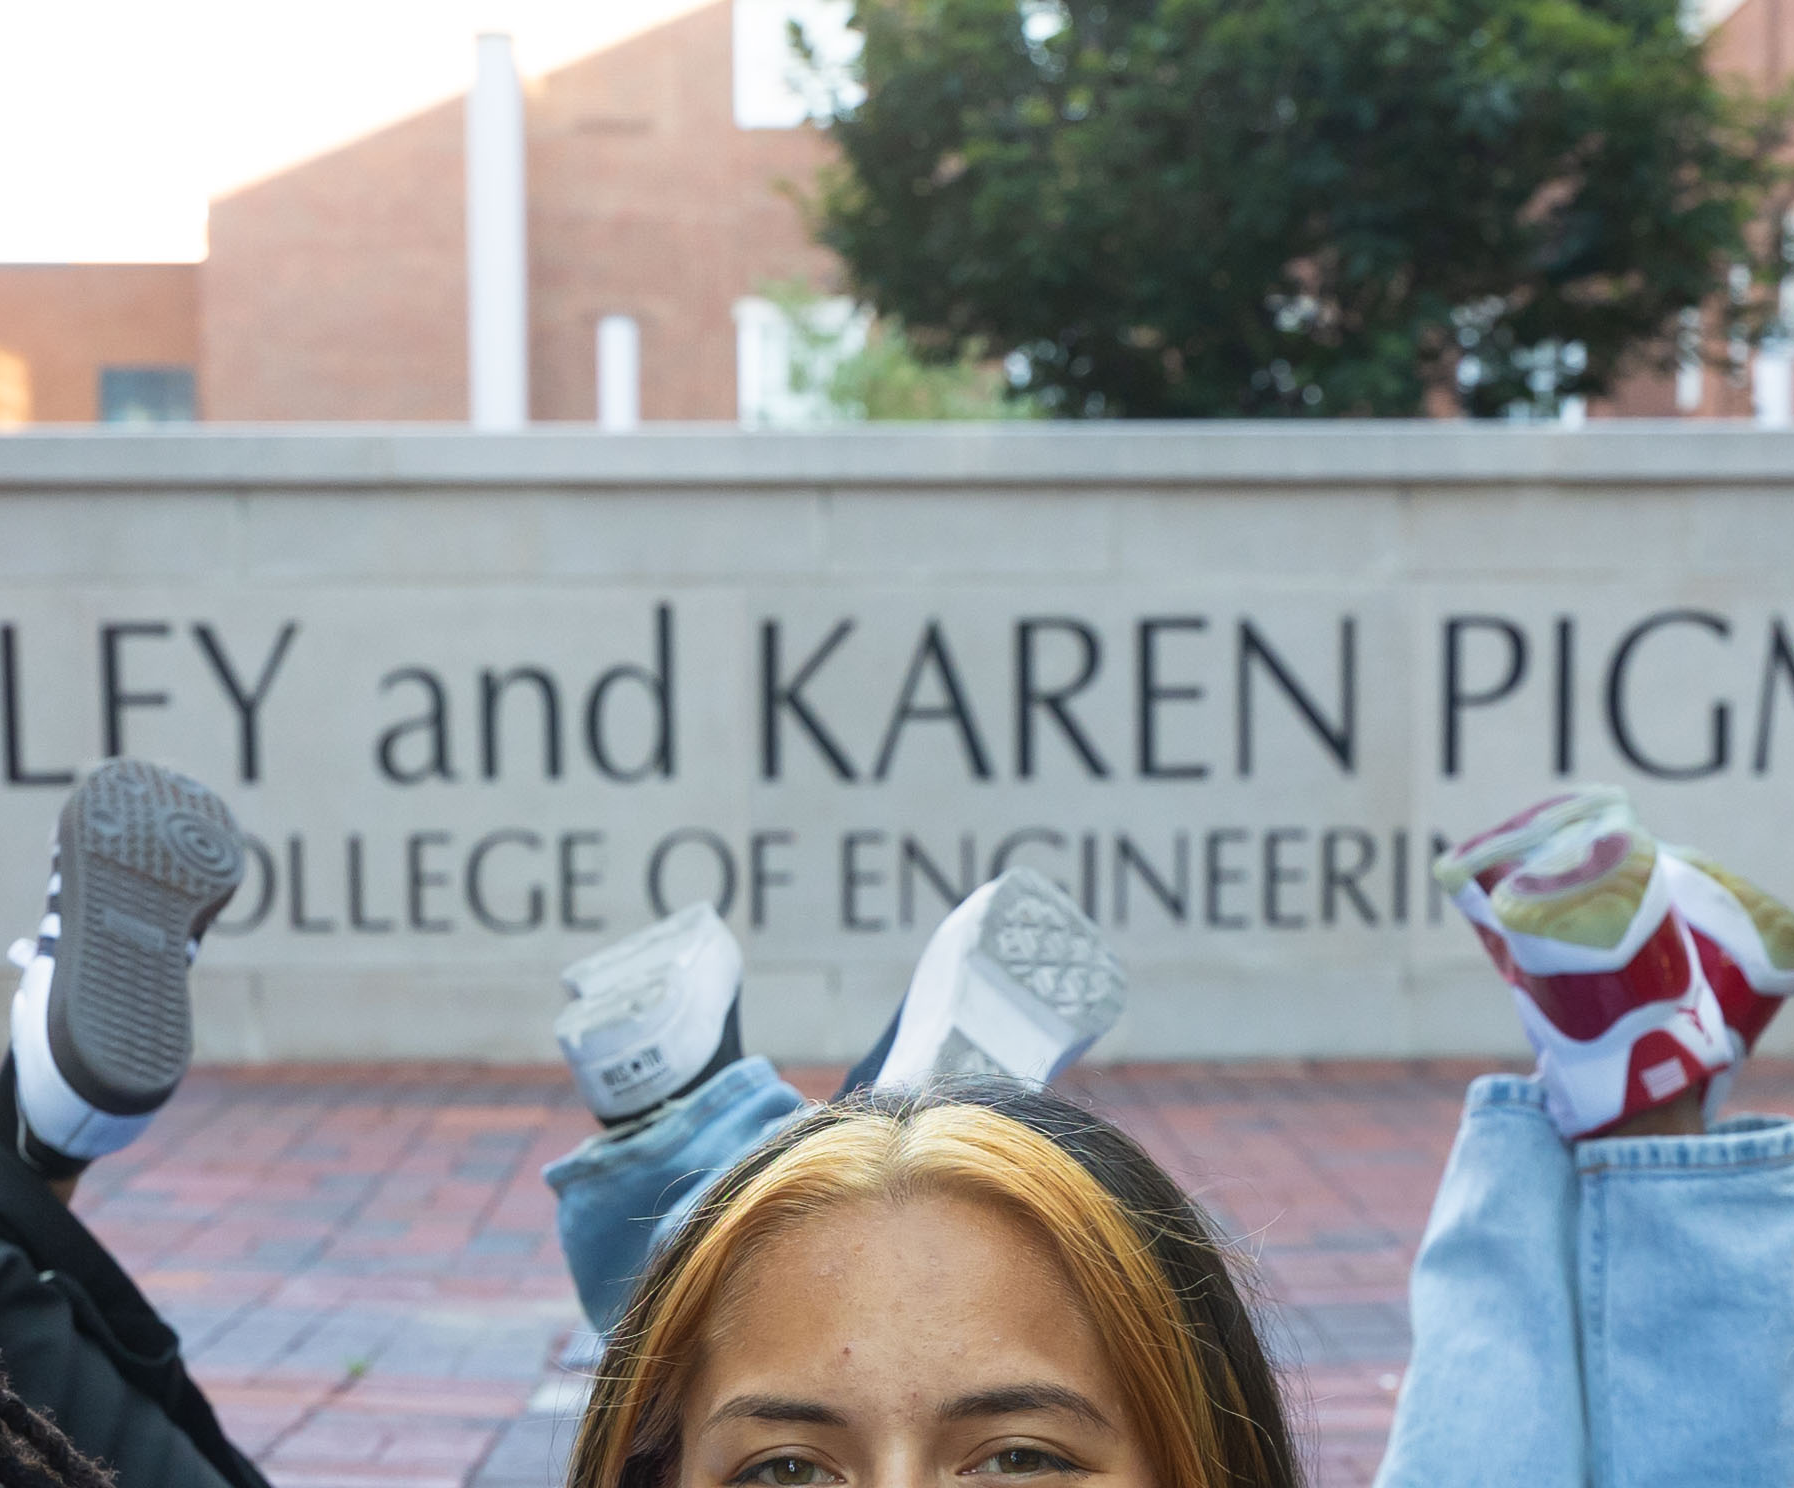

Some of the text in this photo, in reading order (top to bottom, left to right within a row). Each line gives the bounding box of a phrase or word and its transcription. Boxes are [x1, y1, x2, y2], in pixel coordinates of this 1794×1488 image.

[373, 599, 679, 788] and
[757, 612, 1361, 787] KAREN
[210, 828, 603, 936] OLLEGE
[645, 828, 795, 934] OF
